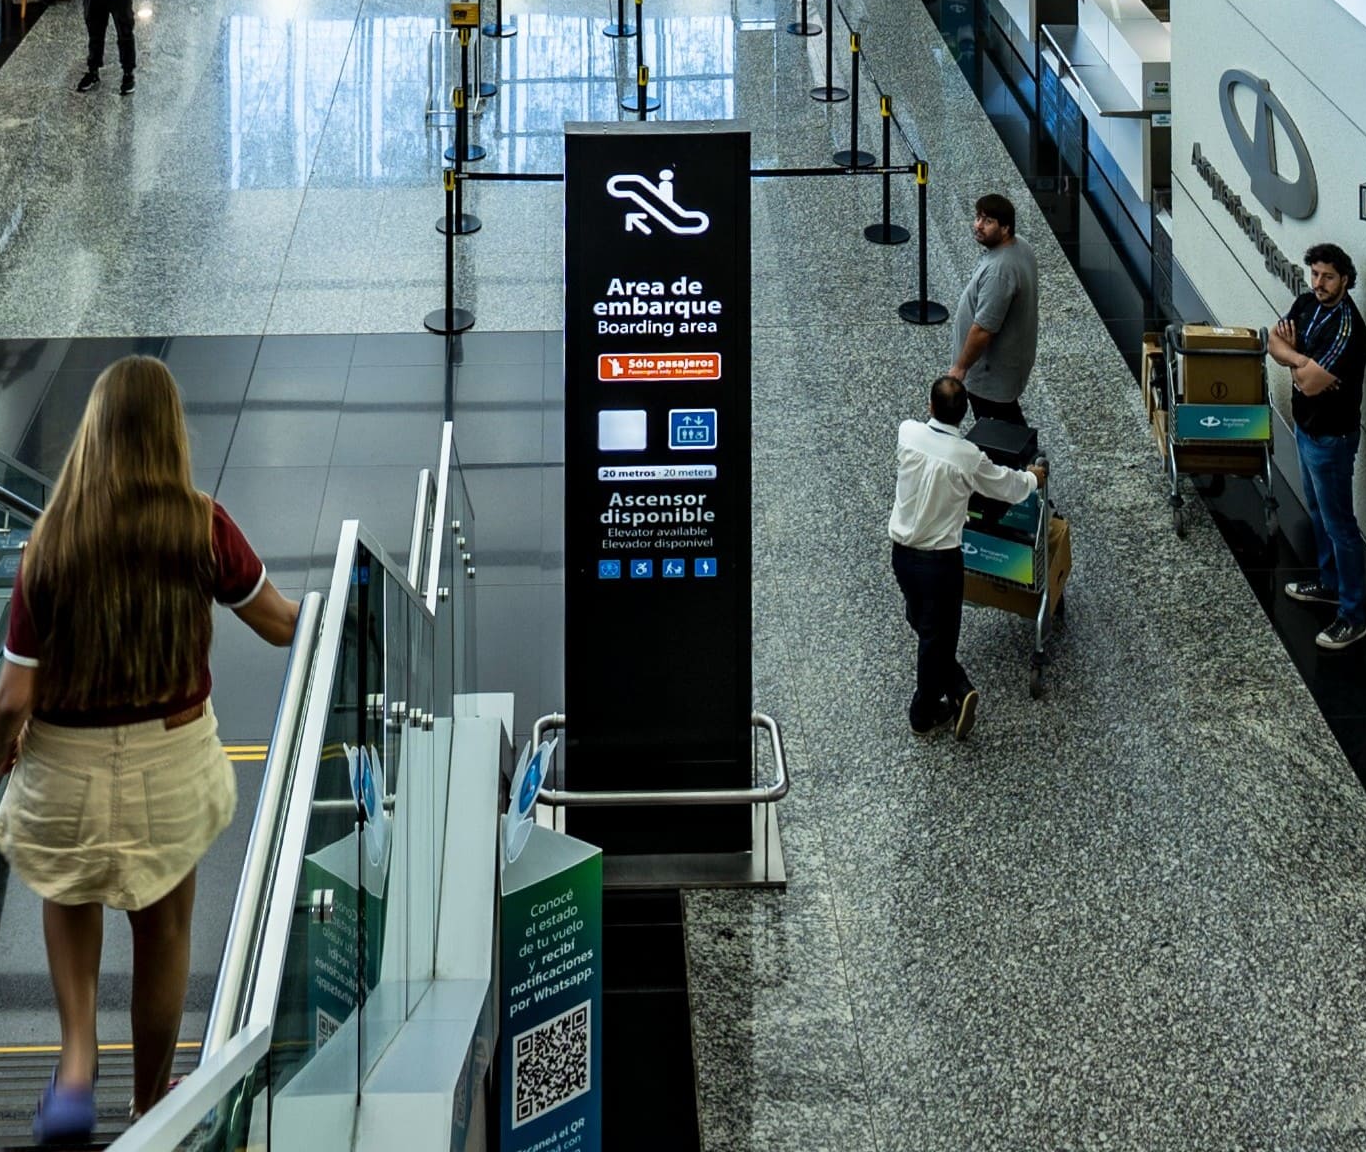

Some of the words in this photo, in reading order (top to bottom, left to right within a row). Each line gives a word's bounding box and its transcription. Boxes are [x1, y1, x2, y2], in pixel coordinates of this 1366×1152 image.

[606, 277, 665, 296] Area
[671, 276, 703, 296] de
[593, 296, 722, 320] embarque
[598, 319, 674, 338] Boarding
[679, 321, 718, 334] area
[627, 357, 655, 369] Sólo
[656, 357, 714, 370] pasajeros
[602, 469, 616, 479] 20
[618, 468, 656, 478] metros
[663, 468, 676, 478] 20
[678, 467, 713, 478] meters
[609, 491, 708, 507] Ascensor
[600, 507, 716, 527] disponible
[607, 527, 654, 538] Elevator
[656, 526, 708, 538] available
[602, 538, 652, 550] Elevador
[654, 537, 714, 550] disponível
[530, 888, 574, 918] Conocé
[525, 922, 536, 938] el
[538, 905, 578, 932] estado
[518, 943, 534, 958] de
[537, 937, 549, 950] tu
[552, 919, 584, 942] vuelo
[528, 959, 536, 974] y
[541, 937, 576, 965] recibí
[510, 948, 594, 997] notificaciones
[509, 997, 532, 1019] por
[534, 967, 595, 1003] Whatsapp.
[559, 1125, 569, 1139] el
[570, 1117, 586, 1133] QR
[563, 1133, 582, 1150] con
